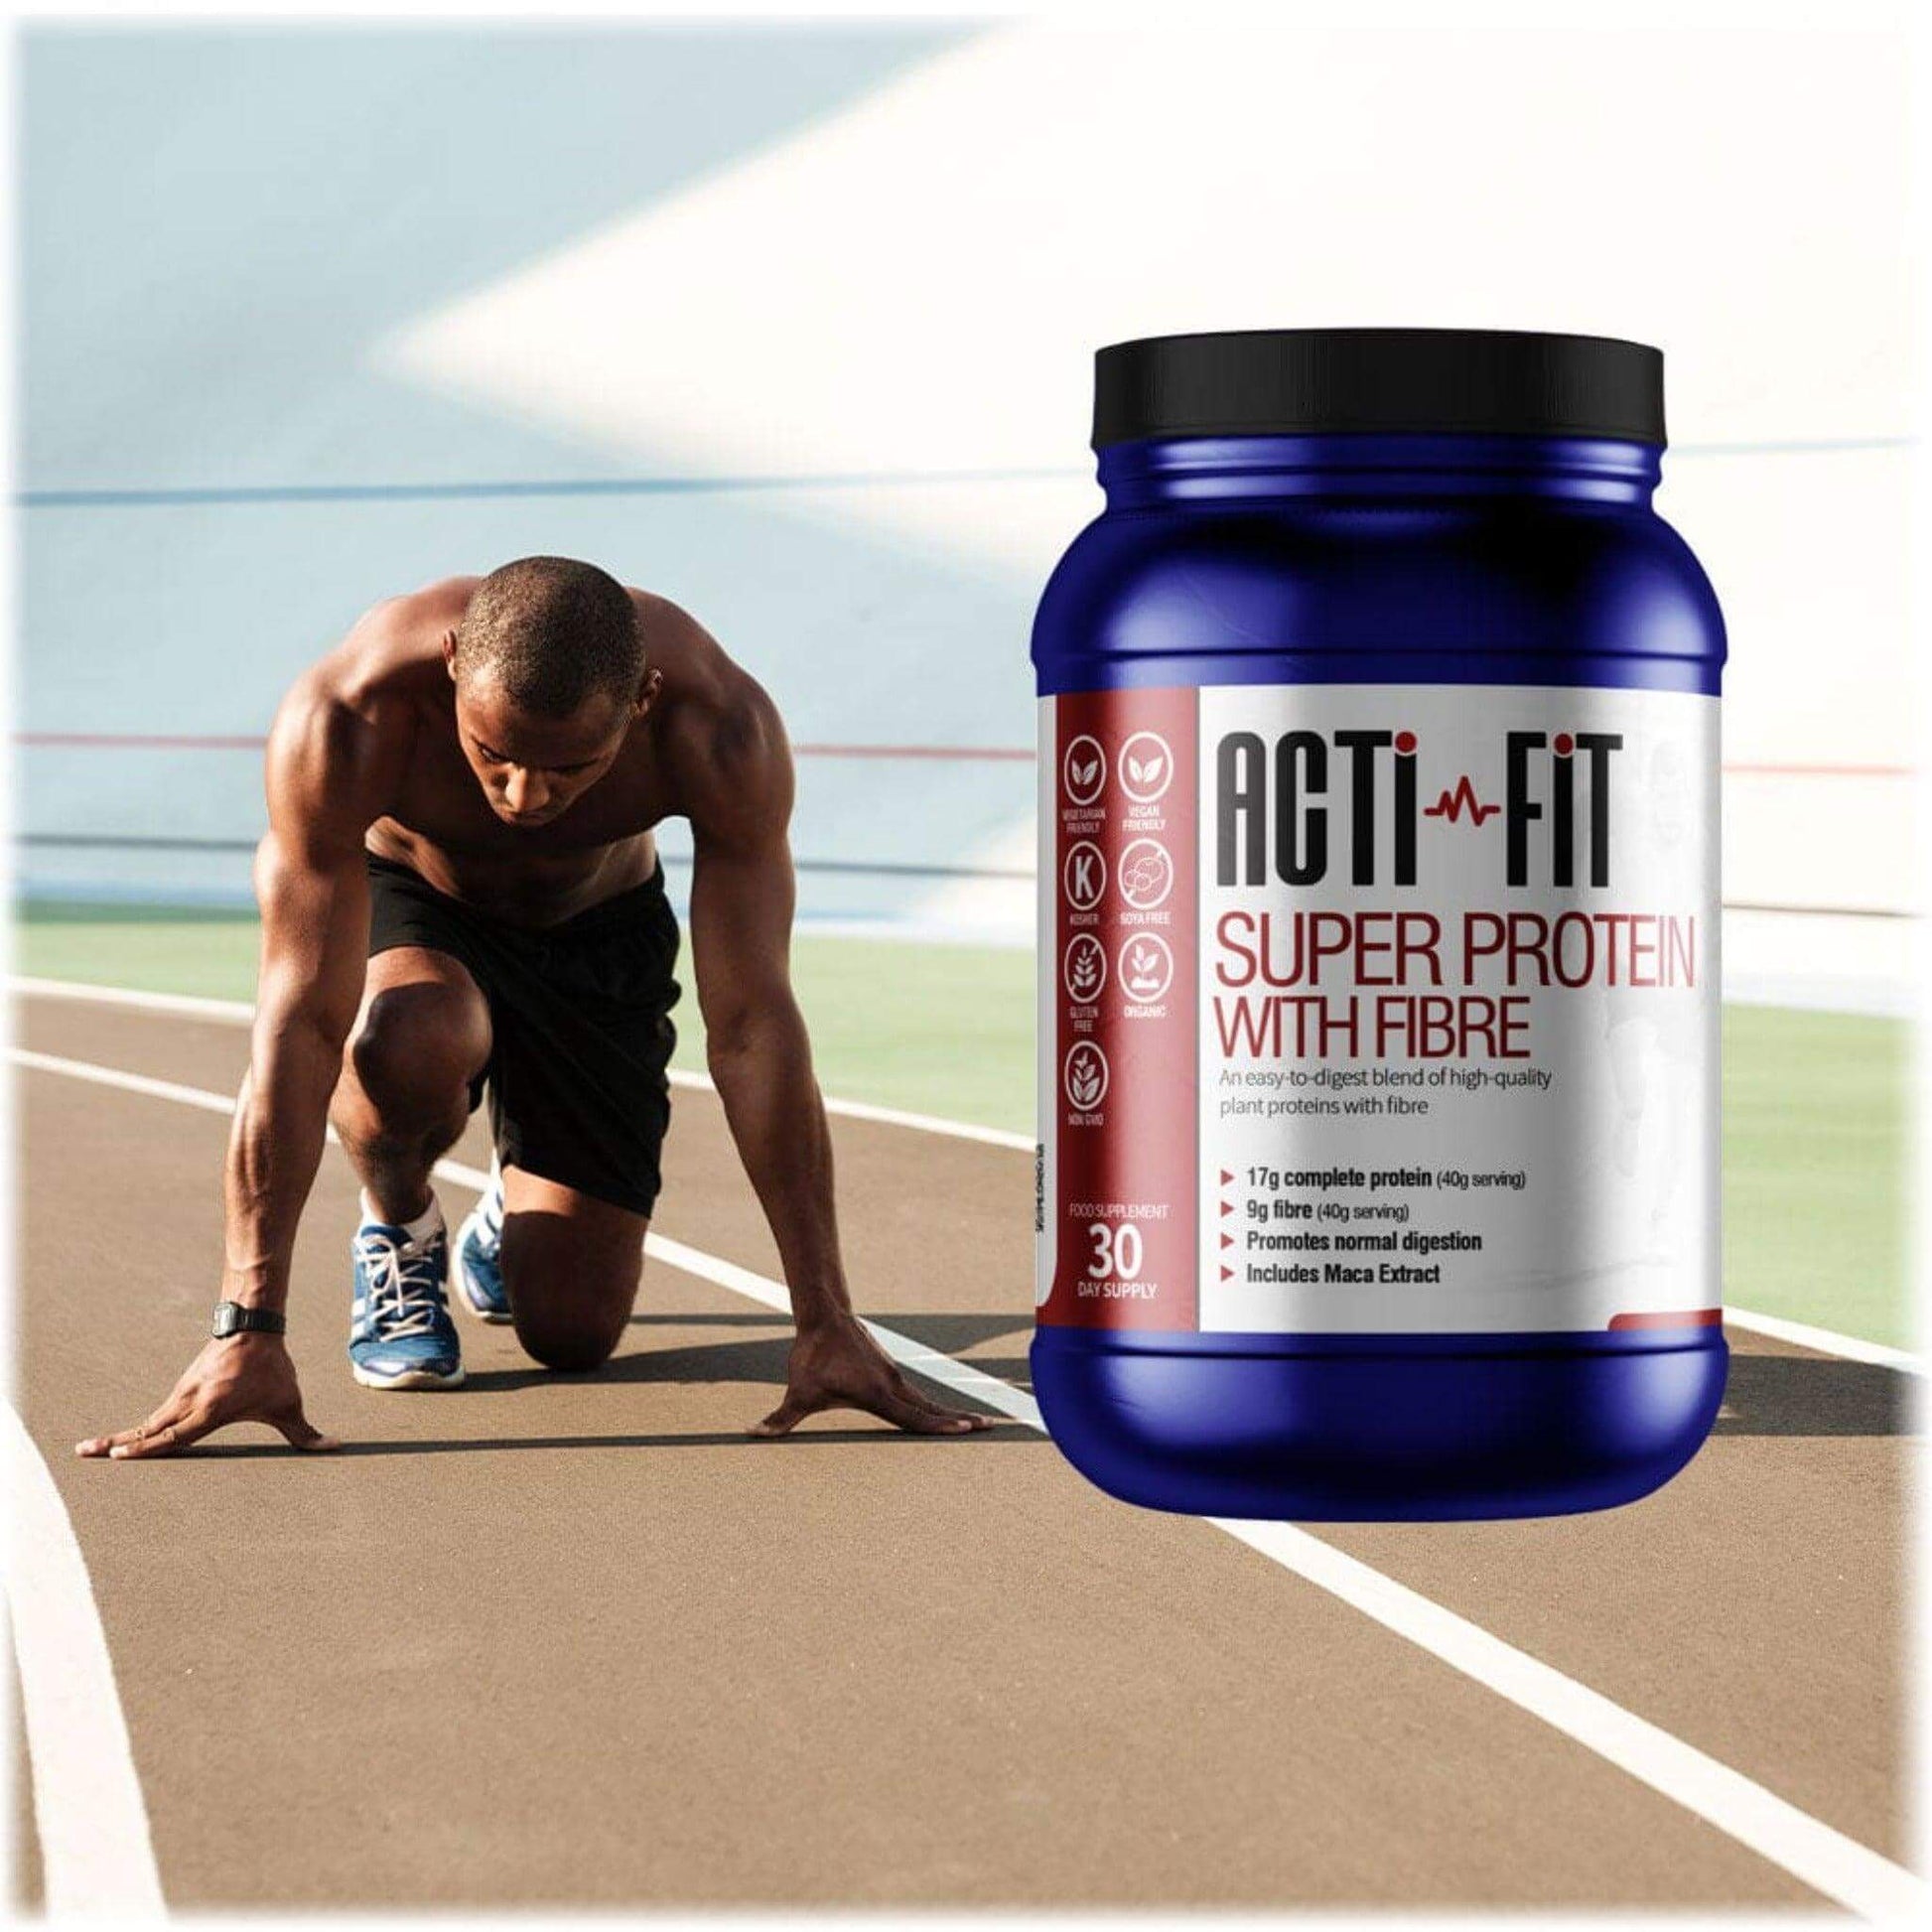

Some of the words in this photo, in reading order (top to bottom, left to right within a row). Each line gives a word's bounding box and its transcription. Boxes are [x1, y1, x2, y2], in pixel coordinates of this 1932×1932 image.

[1128, 805, 1160, 818] VEGAN
[1215, 911, 1443, 989] SUPER
[1462, 911, 1695, 989] PROTEIN
[1212, 996, 1358, 1058] WITH
[1376, 996, 1531, 1058] FIBRE
[1219, 1069, 1241, 1085] An
[1245, 1067, 1368, 1090] easy-to-digest
[1372, 1067, 1424, 1086] blend
[1429, 1067, 1448, 1086] of
[1450, 1067, 1552, 1090] high-quality
[1220, 1096, 1264, 1118] plant
[1267, 1096, 1339, 1117] proteins
[1344, 1096, 1383, 1114] with
[1387, 1095, 1429, 1114] fibre
[1248, 1167, 1280, 1190] 17g
[1285, 1167, 1365, 1190] complete
[1370, 1167, 1432, 1190] protein
[1437, 1170, 1469, 1190] (40g
[1471, 1170, 1526, 1190] serving)
[1069, 1202, 1093, 1217] FOOD
[1095, 1202, 1170, 1219] SUPPLEMENT
[1247, 1199, 1268, 1222] 9g
[1273, 1199, 1312, 1218] fibre
[1316, 1201, 1349, 1222] (40g
[1353, 1202, 1410, 1222] serving)
[1088, 1222, 1143, 1280] 30
[1247, 1231, 1329, 1251] Promotes
[1335, 1231, 1398, 1251] normal
[1402, 1231, 1482, 1254] digestion
[1247, 1264, 1319, 1284] Includes
[1323, 1264, 1374, 1284] Maca
[1379, 1264, 1440, 1284] Extract
[1078, 1281, 1102, 1298] DAY
[1103, 1282, 1159, 1299] SUPPLY
